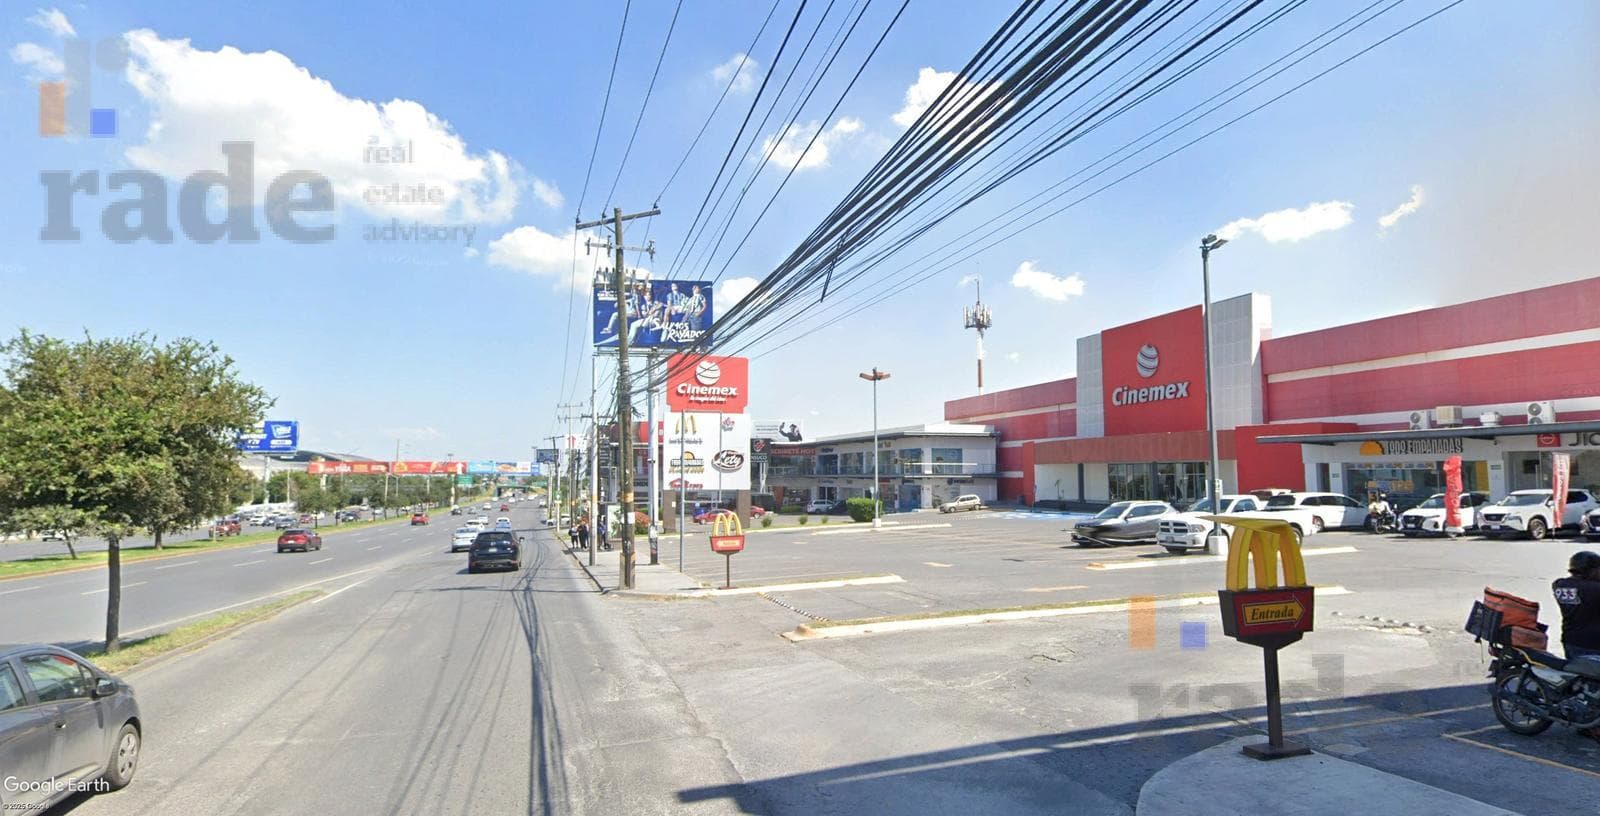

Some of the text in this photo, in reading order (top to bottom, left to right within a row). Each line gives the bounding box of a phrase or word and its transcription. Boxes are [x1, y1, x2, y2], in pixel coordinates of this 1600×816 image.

[677, 382, 738, 396] Cinemex
[1111, 381, 1190, 406] Cinemex
[1407, 438, 1463, 456] EMPANADAS
[1250, 605, 1294, 621] Entrada
